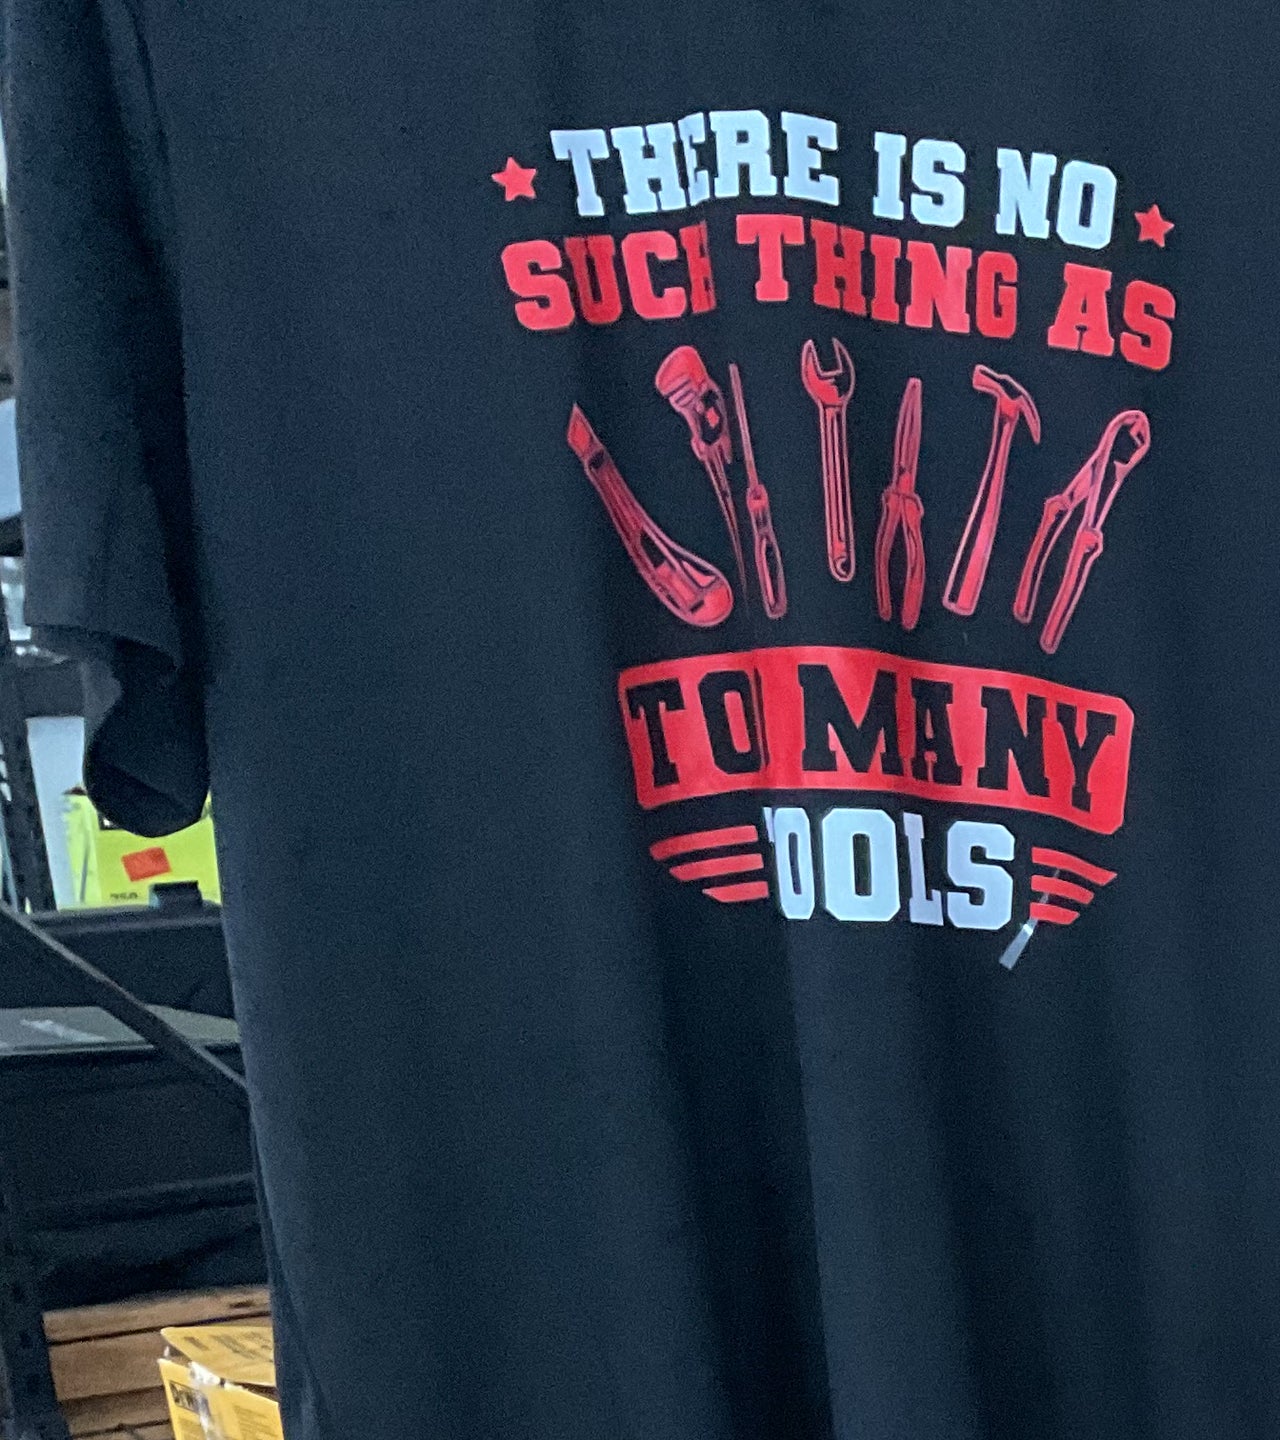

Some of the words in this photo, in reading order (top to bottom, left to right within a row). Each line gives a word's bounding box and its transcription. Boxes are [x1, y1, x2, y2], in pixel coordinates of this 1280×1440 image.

[550, 109, 838, 216] THERE
[873, 132, 966, 228] IS
[996, 147, 1117, 249] NO
[736, 213, 1018, 338] THING
[1048, 262, 1176, 371] AS
[625, 669, 766, 790] TO
[798, 663, 1118, 812] MANY
[762, 807, 1016, 931] OOLS
